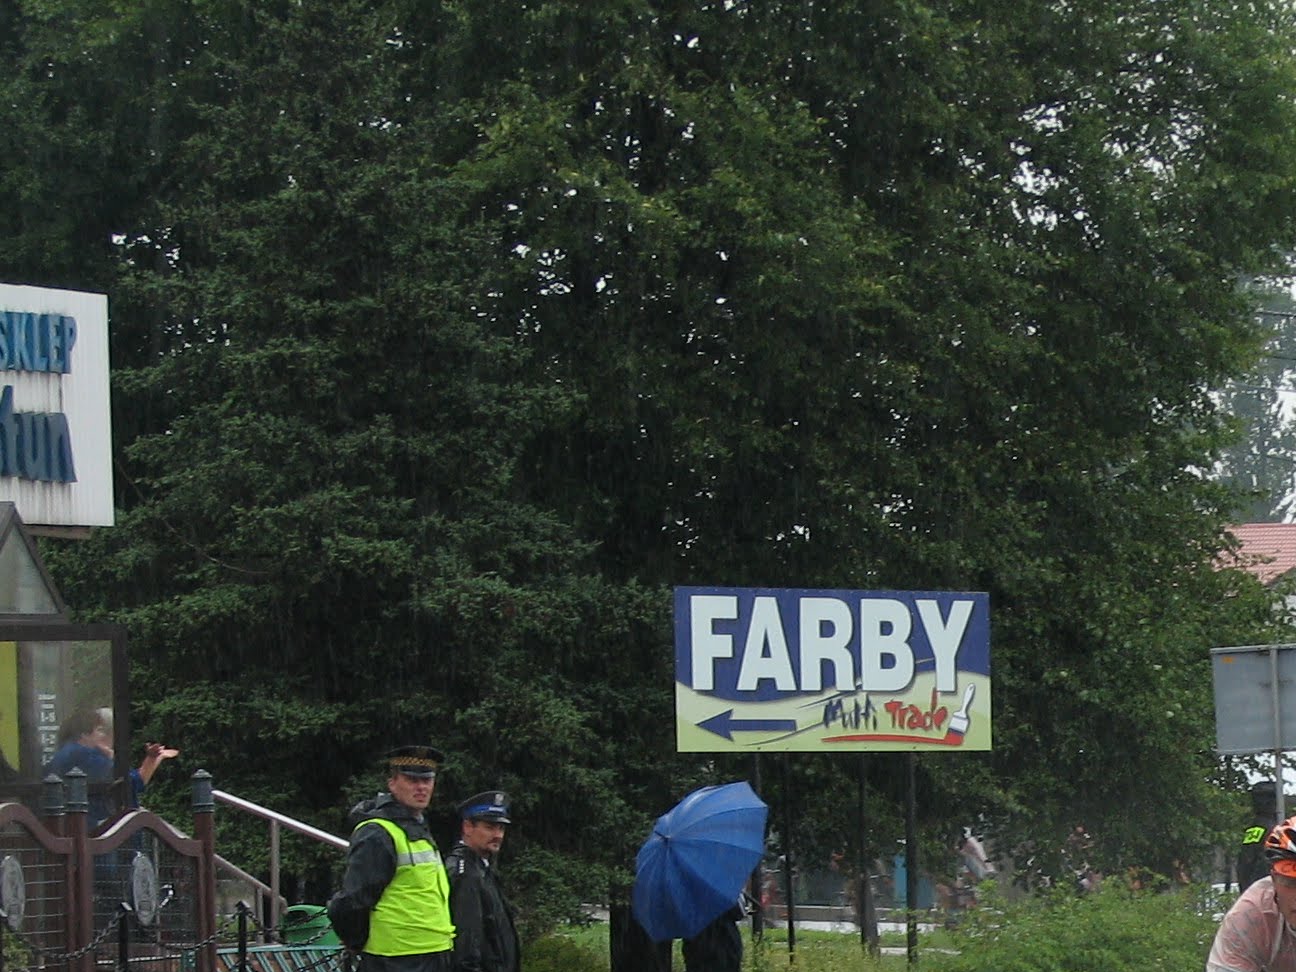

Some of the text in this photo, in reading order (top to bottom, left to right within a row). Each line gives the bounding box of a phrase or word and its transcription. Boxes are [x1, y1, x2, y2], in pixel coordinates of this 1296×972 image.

[690, 595, 974, 692] FARBY
[823, 688, 948, 731] Multi Trade
